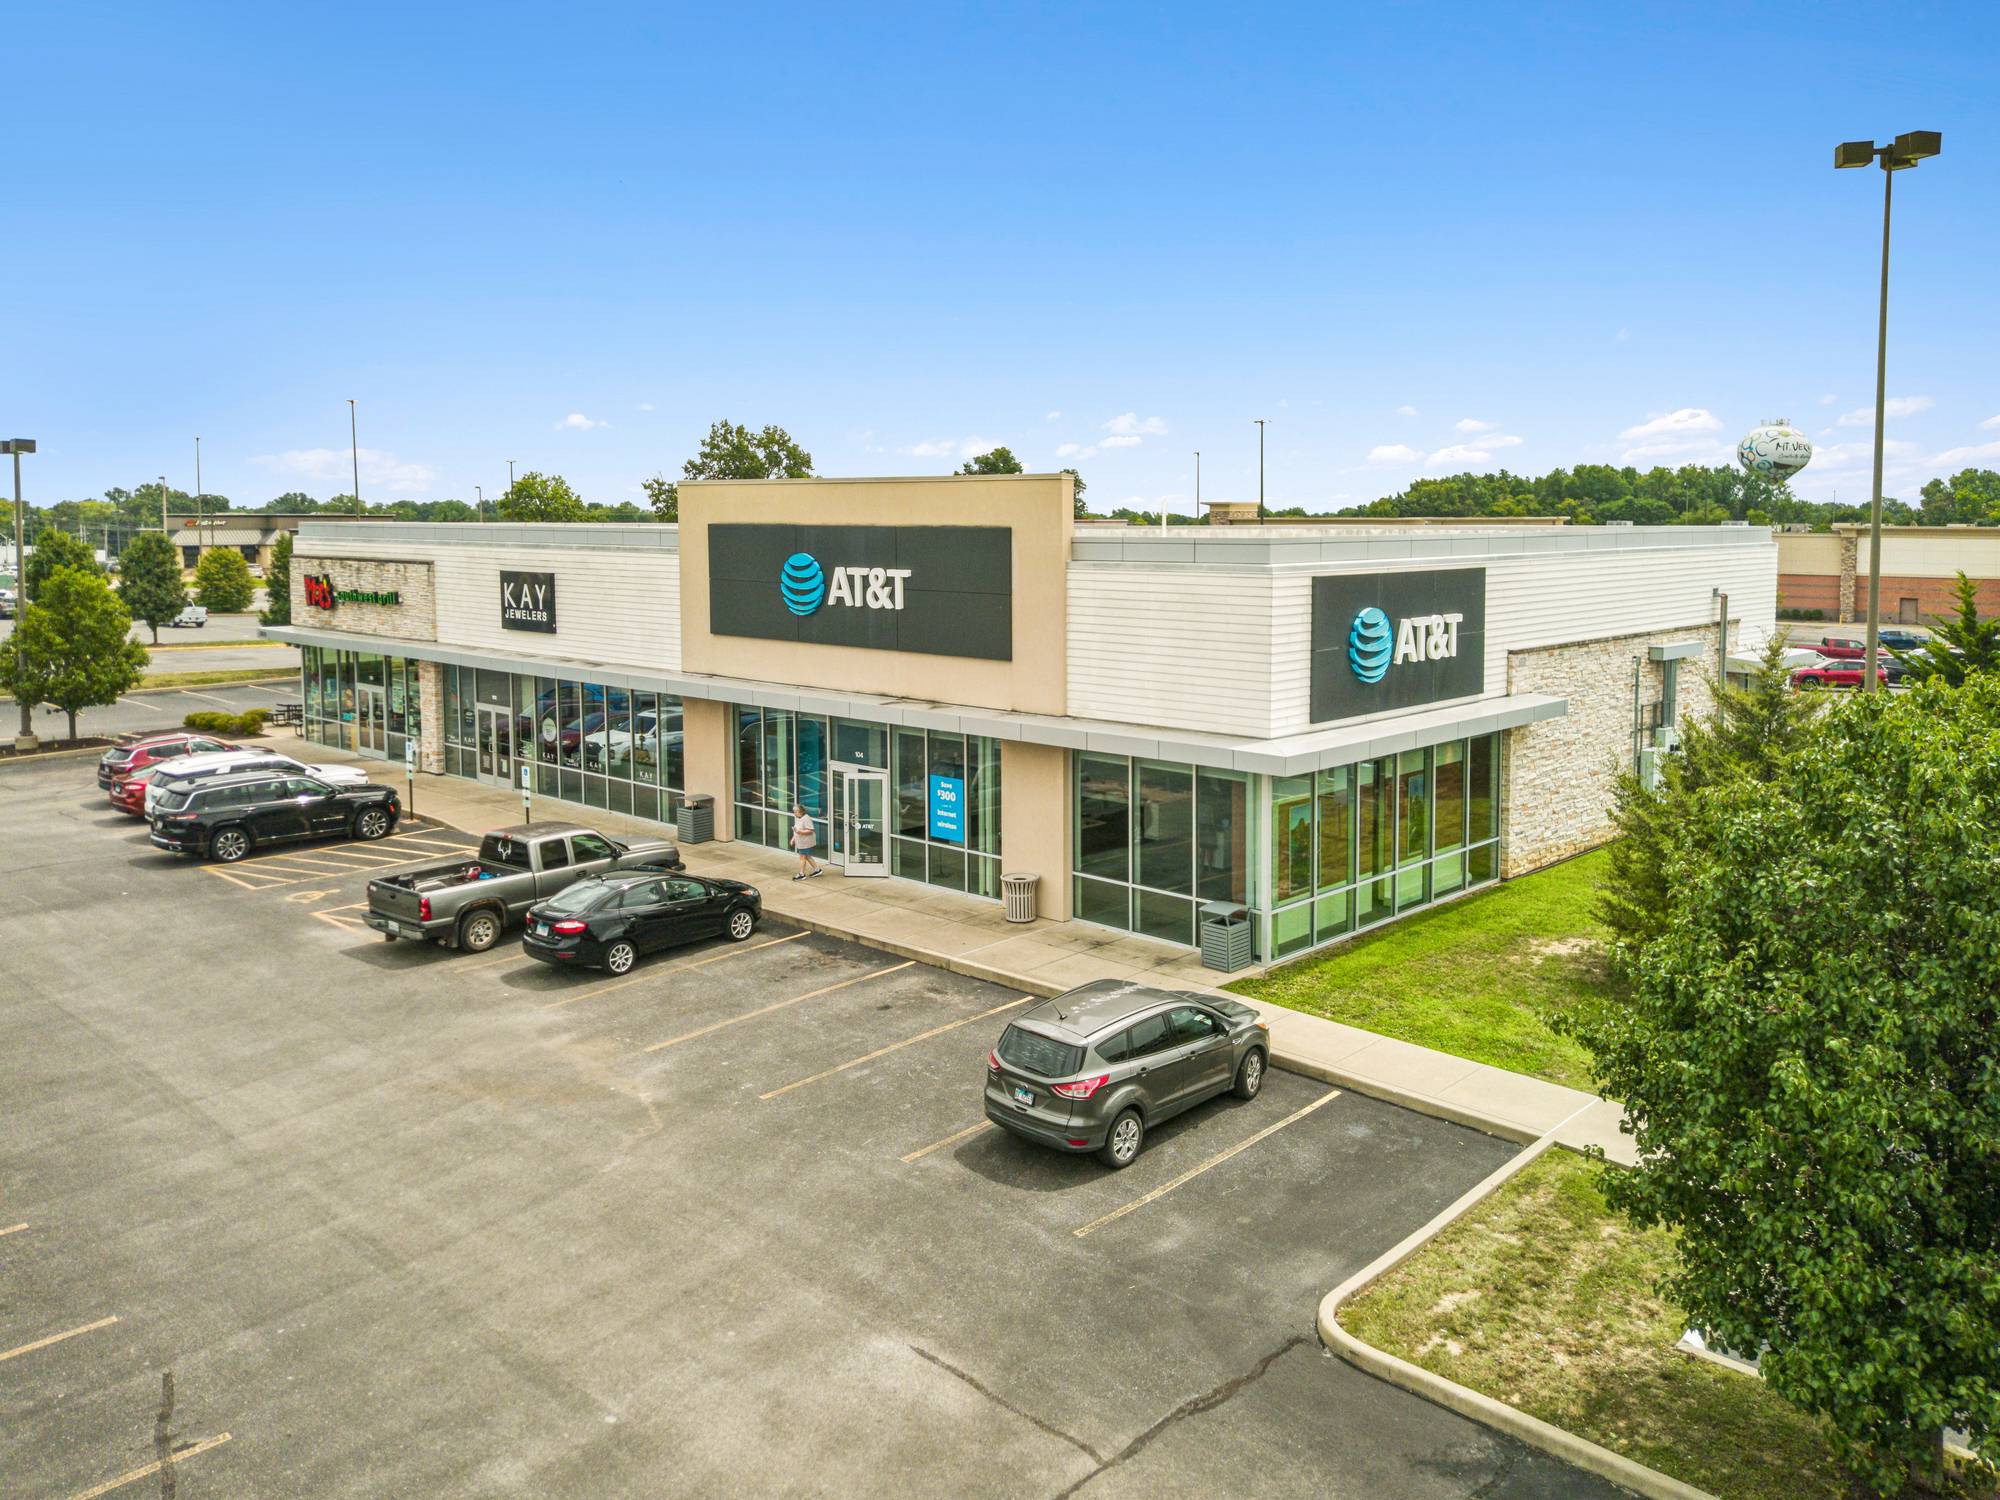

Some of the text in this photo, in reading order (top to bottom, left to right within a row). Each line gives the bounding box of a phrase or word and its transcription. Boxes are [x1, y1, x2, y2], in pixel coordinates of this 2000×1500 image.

[504, 582, 546, 610] KAY
[827, 566, 912, 610] AT&T
[335, 590, 399, 606] southwest grill
[505, 609, 548, 621] JEWELERS
[1393, 613, 1463, 665] AT&T
[855, 751, 864, 759] 104
[937, 789, 956, 802] $300
